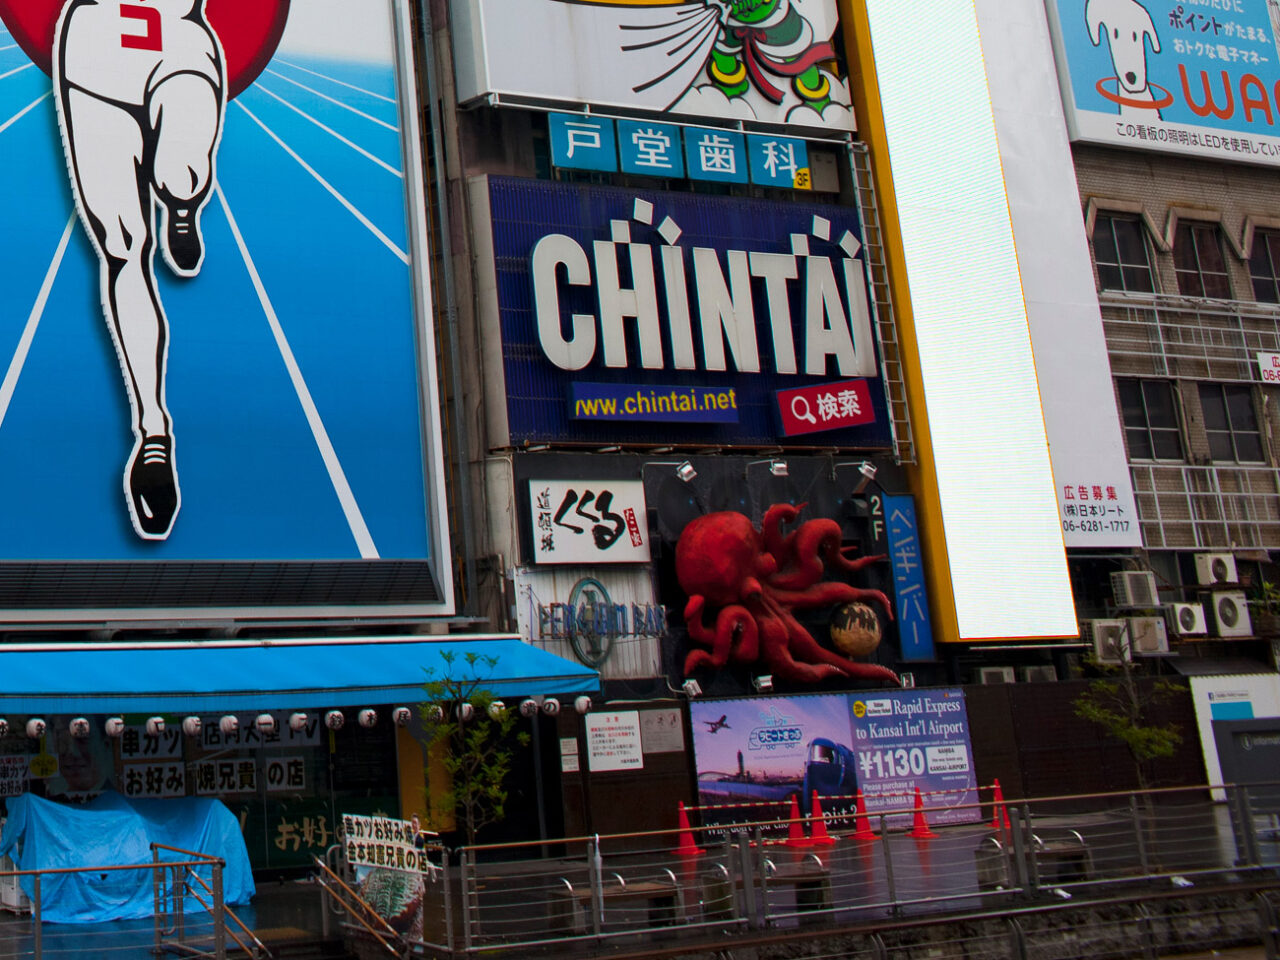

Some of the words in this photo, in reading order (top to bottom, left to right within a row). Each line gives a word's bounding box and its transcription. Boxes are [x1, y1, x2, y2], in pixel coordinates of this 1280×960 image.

[1173, 37, 1269, 65] おトクな電子マネー
[1178, 63, 1280, 127] WA
[564, 122, 798, 180] 戸堂歯科
[795, 172, 809, 188] 3F
[532, 198, 878, 377] CHINTAI
[575, 388, 737, 416] ww.chintai.net
[816, 389, 862, 422] 検索
[1063, 484, 1118, 501] 広告募集
[553, 488, 626, 551] くくる
[870, 494, 884, 542] 2F
[1062, 520, 1130, 532] 06-6281-1717
[1063, 503, 1124, 517] (株)日本リート
[890, 508, 926, 645] ペンギンバー
[892, 697, 923, 719] Rapid
[924, 697, 961, 718] Express
[122, 727, 180, 756] 串カツ
[855, 728, 867, 739] to
[868, 722, 903, 739] Kansai
[905, 720, 927, 736] Int'l
[928, 720, 964, 739] Airport
[126, 766, 184, 796] お好み
[197, 761, 256, 790] 焼兄貴
[268, 759, 305, 787] の店
[858, 747, 926, 779] ¥1,130
[347, 840, 428, 872] 金本知憲兄貴の店
